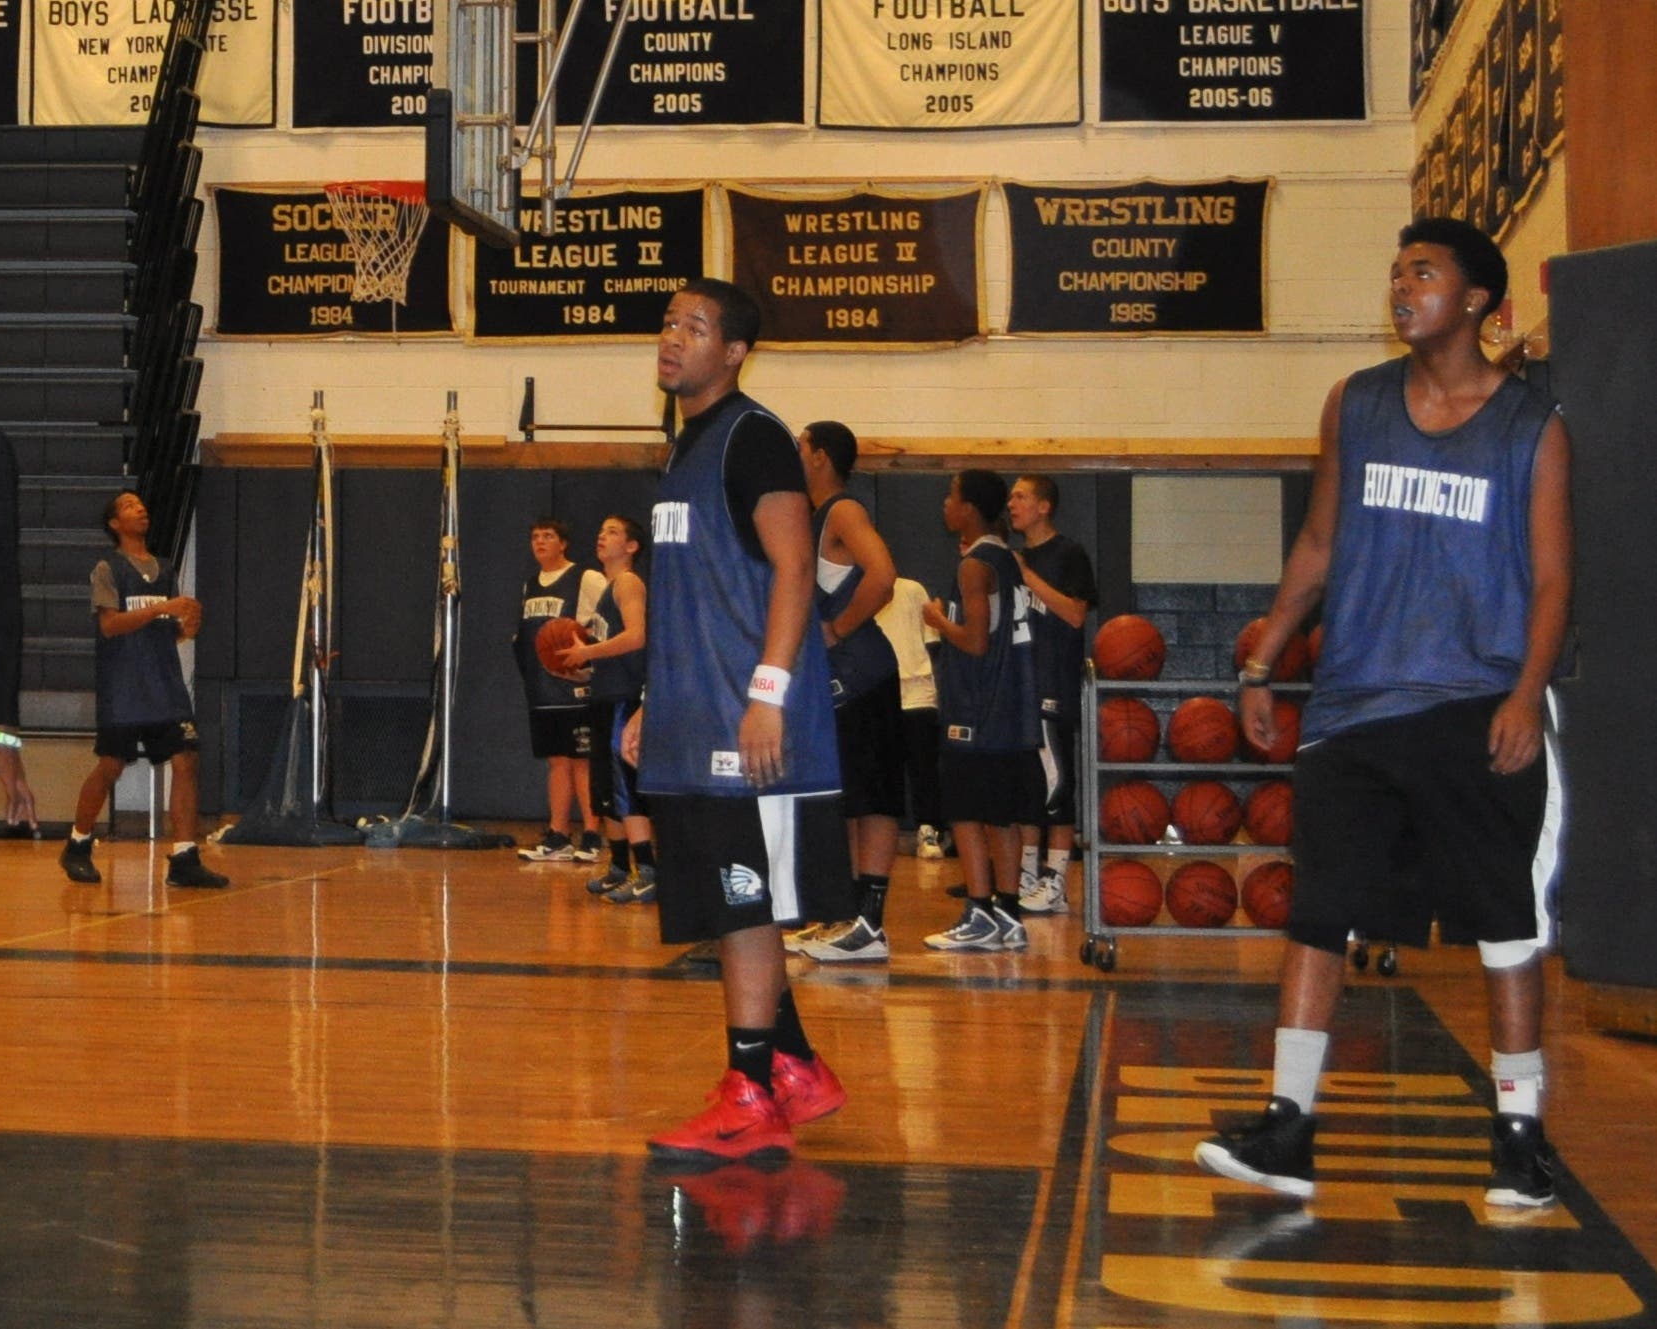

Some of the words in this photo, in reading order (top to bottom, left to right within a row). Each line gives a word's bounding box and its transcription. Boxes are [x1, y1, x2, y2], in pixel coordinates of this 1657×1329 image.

[48, 0, 109, 26] BOYS
[78, 38, 110, 55] NEW
[126, 35, 165, 54] YORK
[363, 35, 433, 54] DIVISION
[644, 32, 712, 52] COUNTY
[887, 32, 933, 50] LONG
[949, 31, 1012, 49] ISLAND
[1180, 25, 1252, 46] LEAGUE
[630, 62, 725, 83] CHAMPIONS
[900, 63, 999, 82] CHAMPIONS
[1179, 56, 1282, 77] CHAMPIONS
[391, 96, 427, 115] 200
[654, 94, 702, 113] 2005
[925, 95, 974, 113] 2005
[1189, 87, 1273, 108] 2005-06
[1033, 196, 1236, 227] WRESTLING
[785, 211, 922, 234] WRESTLING
[284, 243, 356, 263] LEAGUE
[514, 244, 618, 268] LEAGUE
[637, 242, 663, 266] IV
[788, 245, 879, 265] LEAGUE
[897, 242, 917, 262] IV
[1092, 237, 1177, 259] COUNTY
[490, 278, 585, 295] TOURNAMENT
[604, 277, 688, 292] CHAMPIONS
[771, 275, 936, 297] CHAMPIONSHIP
[1059, 271, 1208, 292] CHAMPIONSHIP
[310, 306, 353, 326] 1984
[563, 304, 616, 325] 1984
[825, 307, 880, 329] 1984
[1109, 303, 1156, 323] 1985
[1363, 463, 1489, 522] HUNTINGTON
